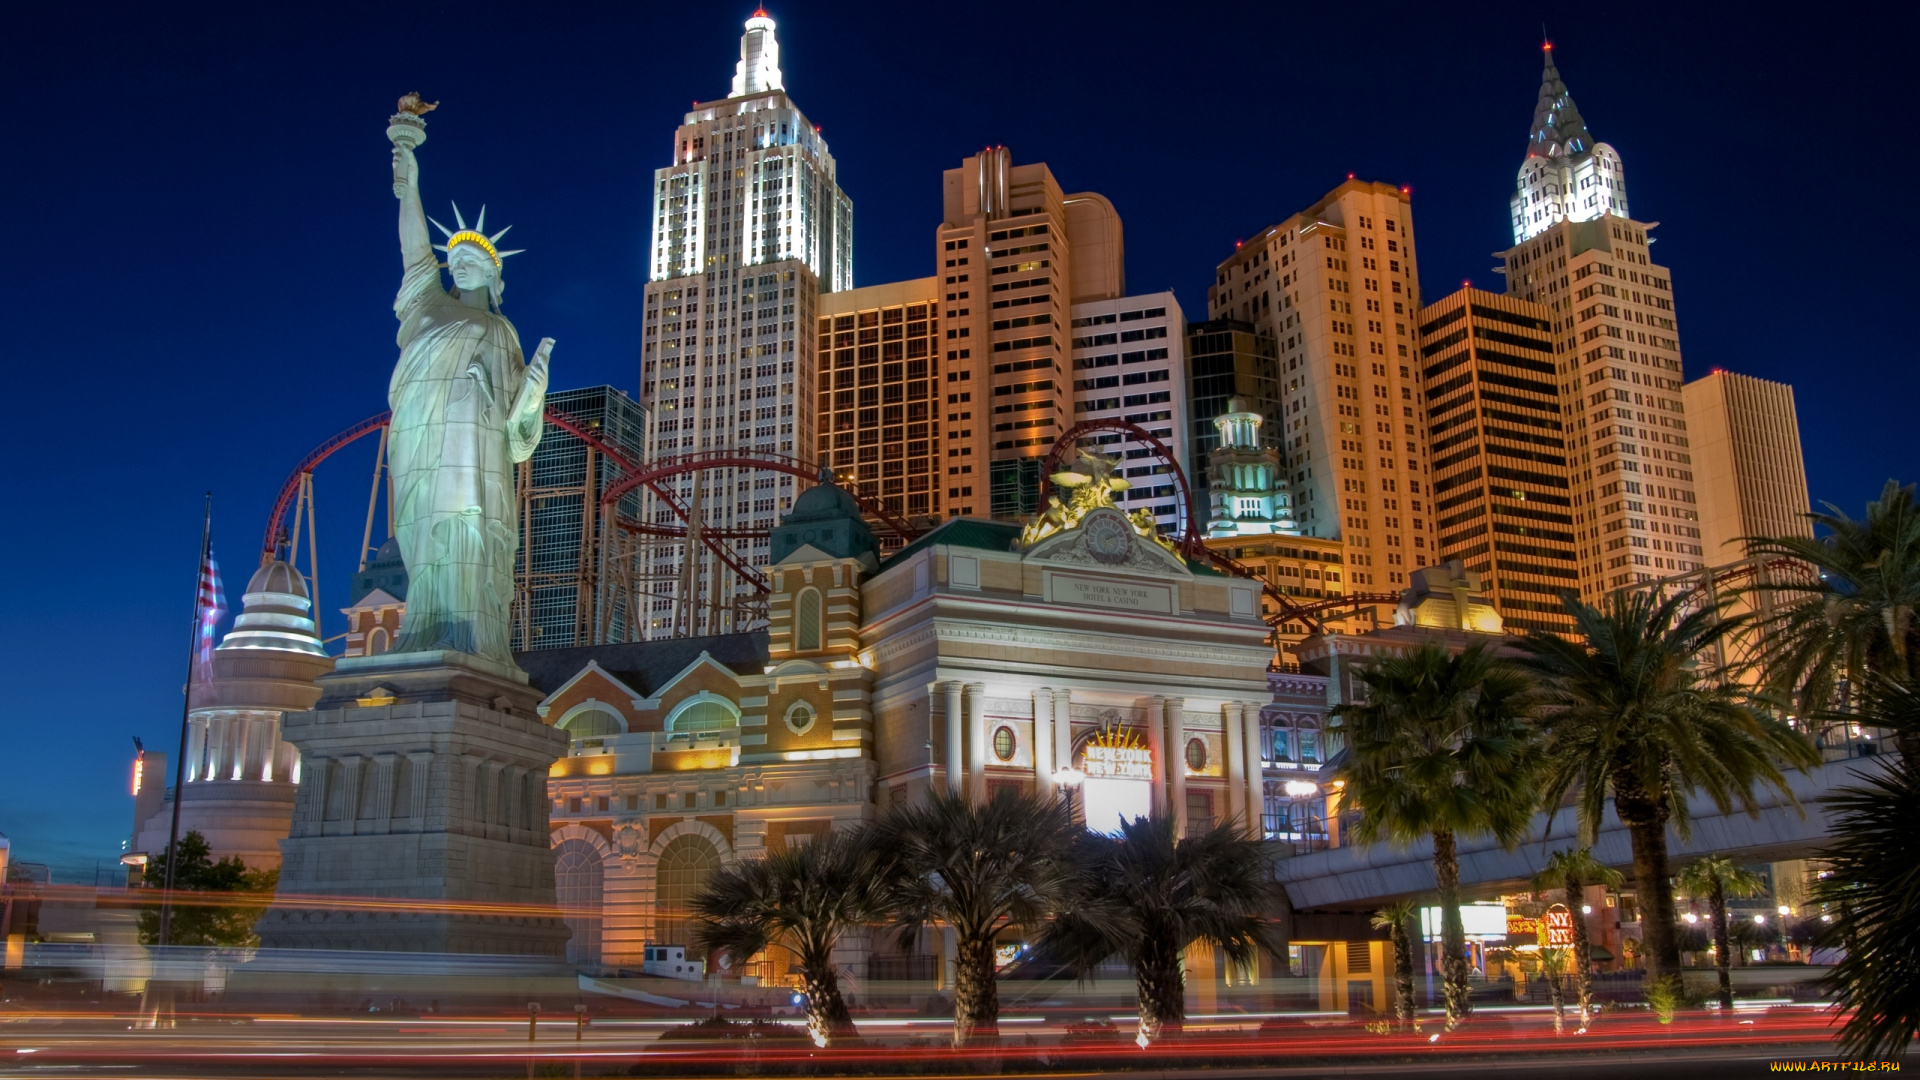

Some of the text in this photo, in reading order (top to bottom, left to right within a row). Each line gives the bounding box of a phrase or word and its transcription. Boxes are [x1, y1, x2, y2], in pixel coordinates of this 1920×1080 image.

[1074, 584, 1090, 592] NEW
[1092, 585, 1110, 594] YORK
[1130, 590, 1148, 598] YORK
[1083, 593, 1104, 602] HOTEL
[1114, 596, 1139, 605] CASINO
[1549, 912, 1569, 927] NY
[1549, 929, 1570, 943] NY
